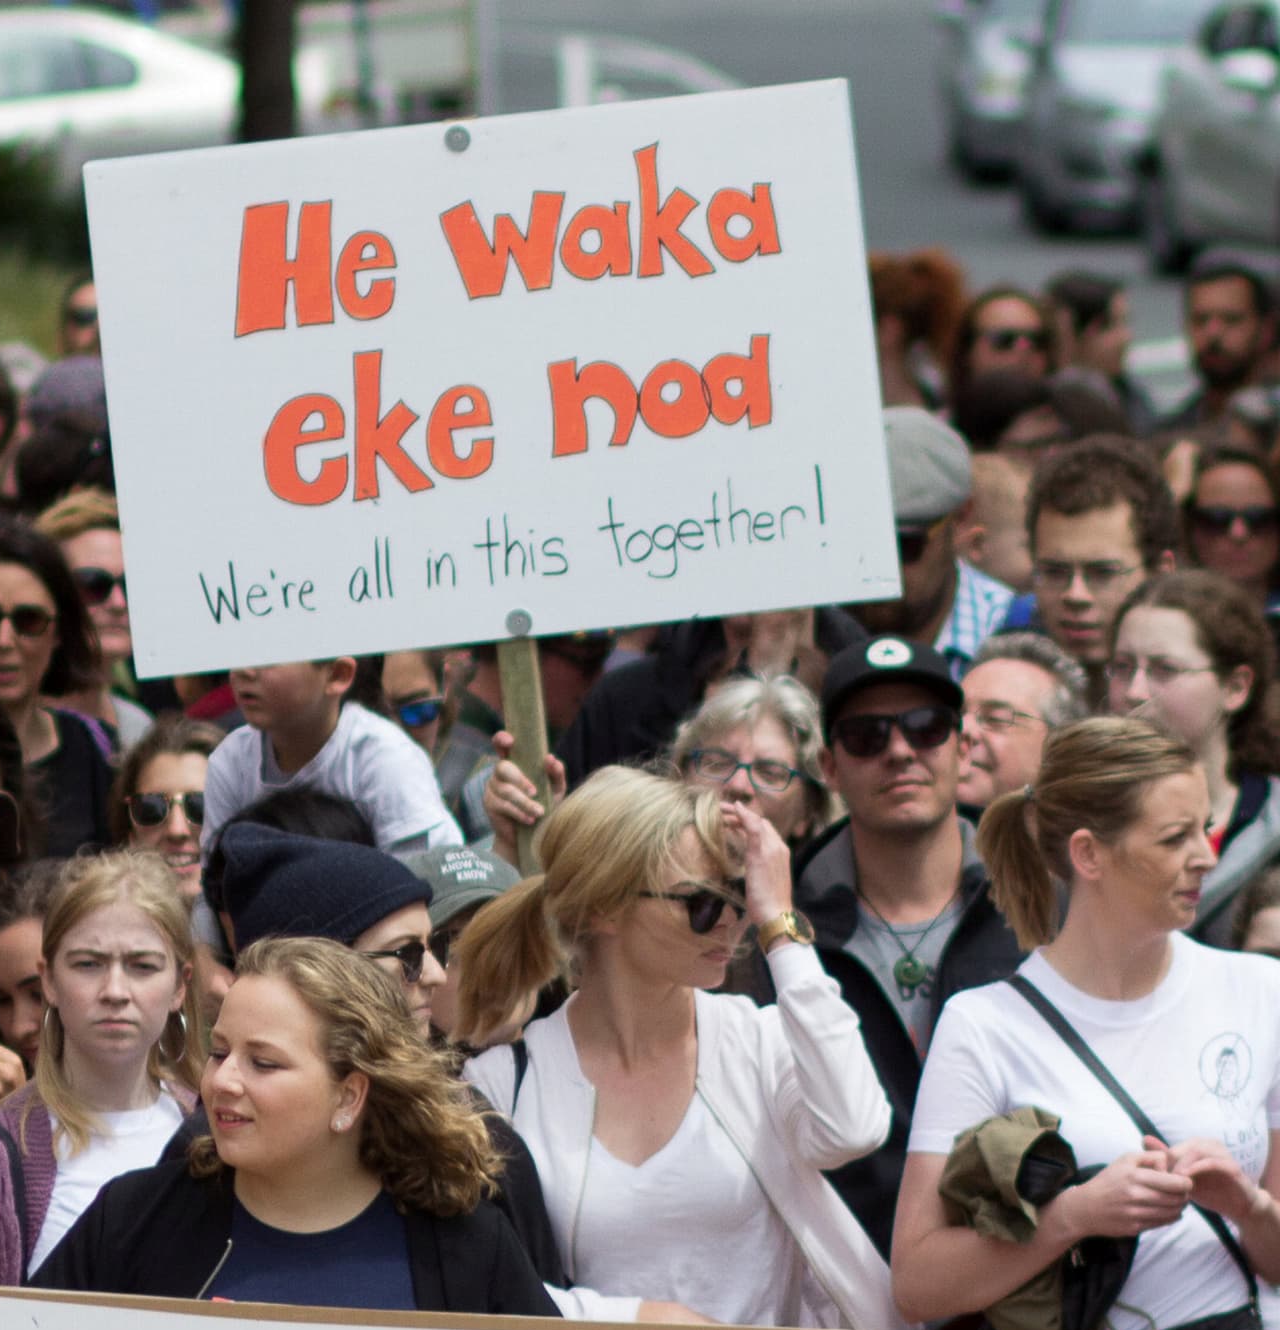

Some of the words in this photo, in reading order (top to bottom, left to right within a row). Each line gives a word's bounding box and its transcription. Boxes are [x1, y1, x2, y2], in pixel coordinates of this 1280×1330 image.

[236, 201, 397, 337] He
[439, 142, 781, 300] waka
[263, 350, 494, 507] eke
[548, 334, 773, 458] noa
[198, 560, 316, 626] We're
[347, 537, 394, 604] all
[426, 549, 457, 590] in
[473, 515, 570, 586] this
[598, 464, 826, 580] together!
